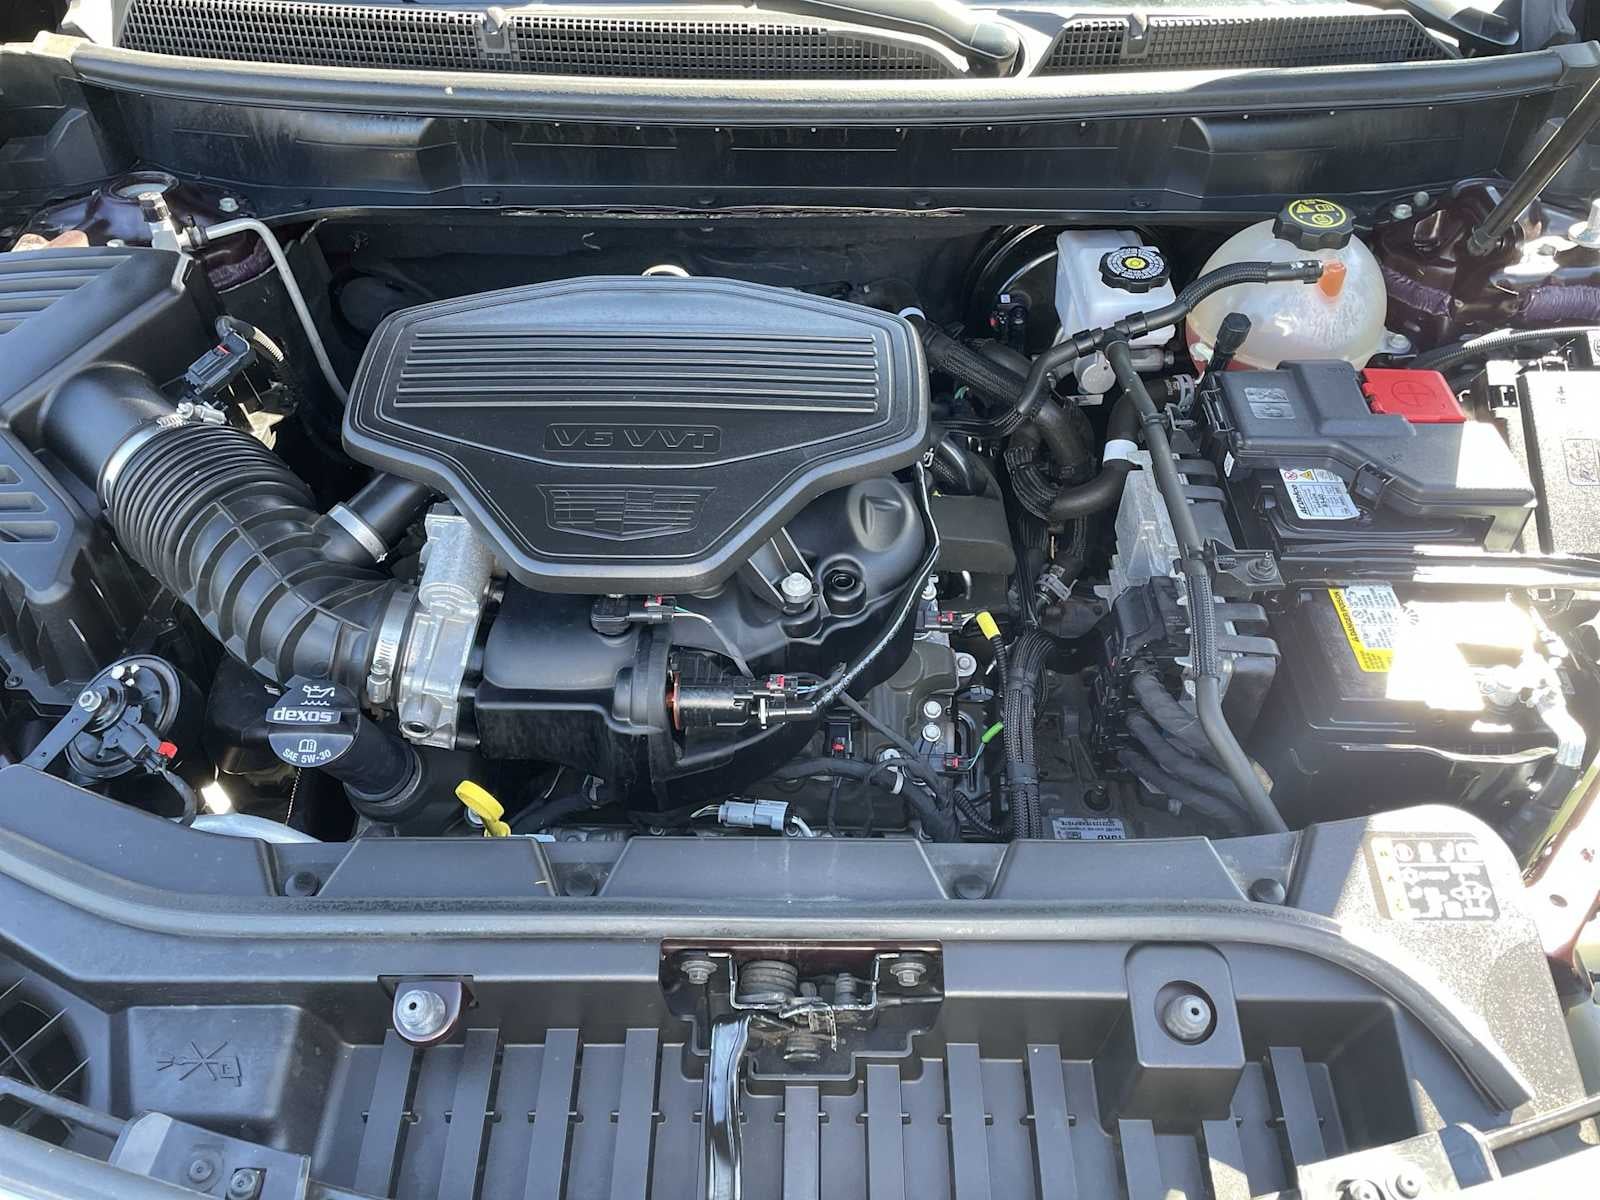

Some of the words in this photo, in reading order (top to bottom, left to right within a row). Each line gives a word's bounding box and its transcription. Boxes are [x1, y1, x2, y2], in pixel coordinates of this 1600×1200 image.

[552, 428, 615, 447] V6
[623, 428, 714, 449] VVT
[273, 707, 334, 722] dexos
[282, 748, 299, 762] SAE
[301, 749, 332, 763] 5W-30
